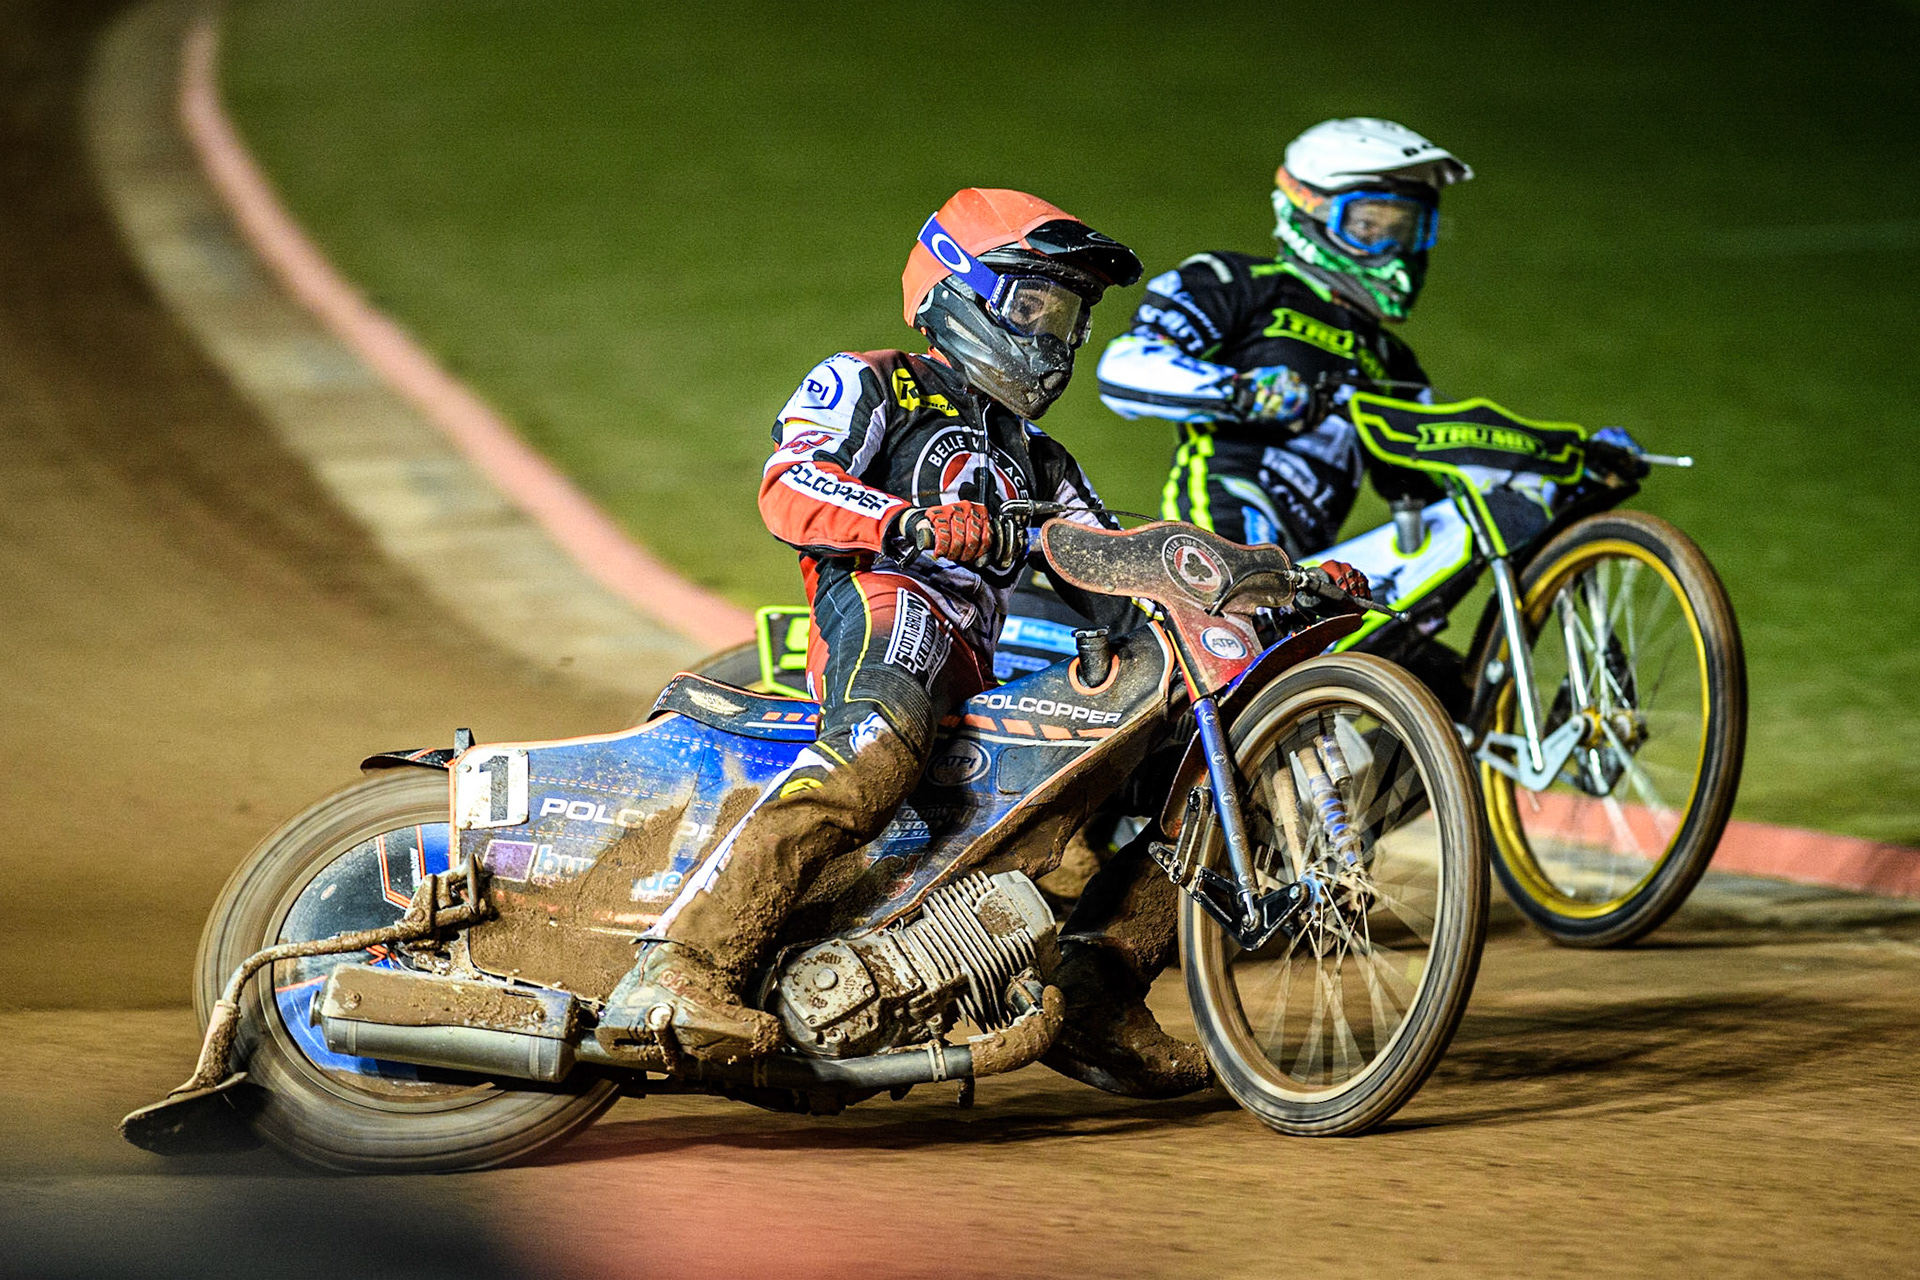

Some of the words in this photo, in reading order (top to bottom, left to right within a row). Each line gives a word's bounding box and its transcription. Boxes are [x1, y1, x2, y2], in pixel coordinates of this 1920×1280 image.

[806, 379, 830, 401] PI
[928, 435, 966, 467] BELLE
[972, 437, 1000, 463] VE
[1004, 467, 1030, 499] ACE
[1166, 539, 1181, 560] BELLE
[895, 629, 919, 671] SCOTT
[1212, 638, 1239, 648] ATPI
[970, 694, 1123, 724] POLCOPPER
[937, 755, 977, 769] ATPI
[479, 756, 509, 821] 1
[540, 798, 717, 842] POLCOPP
